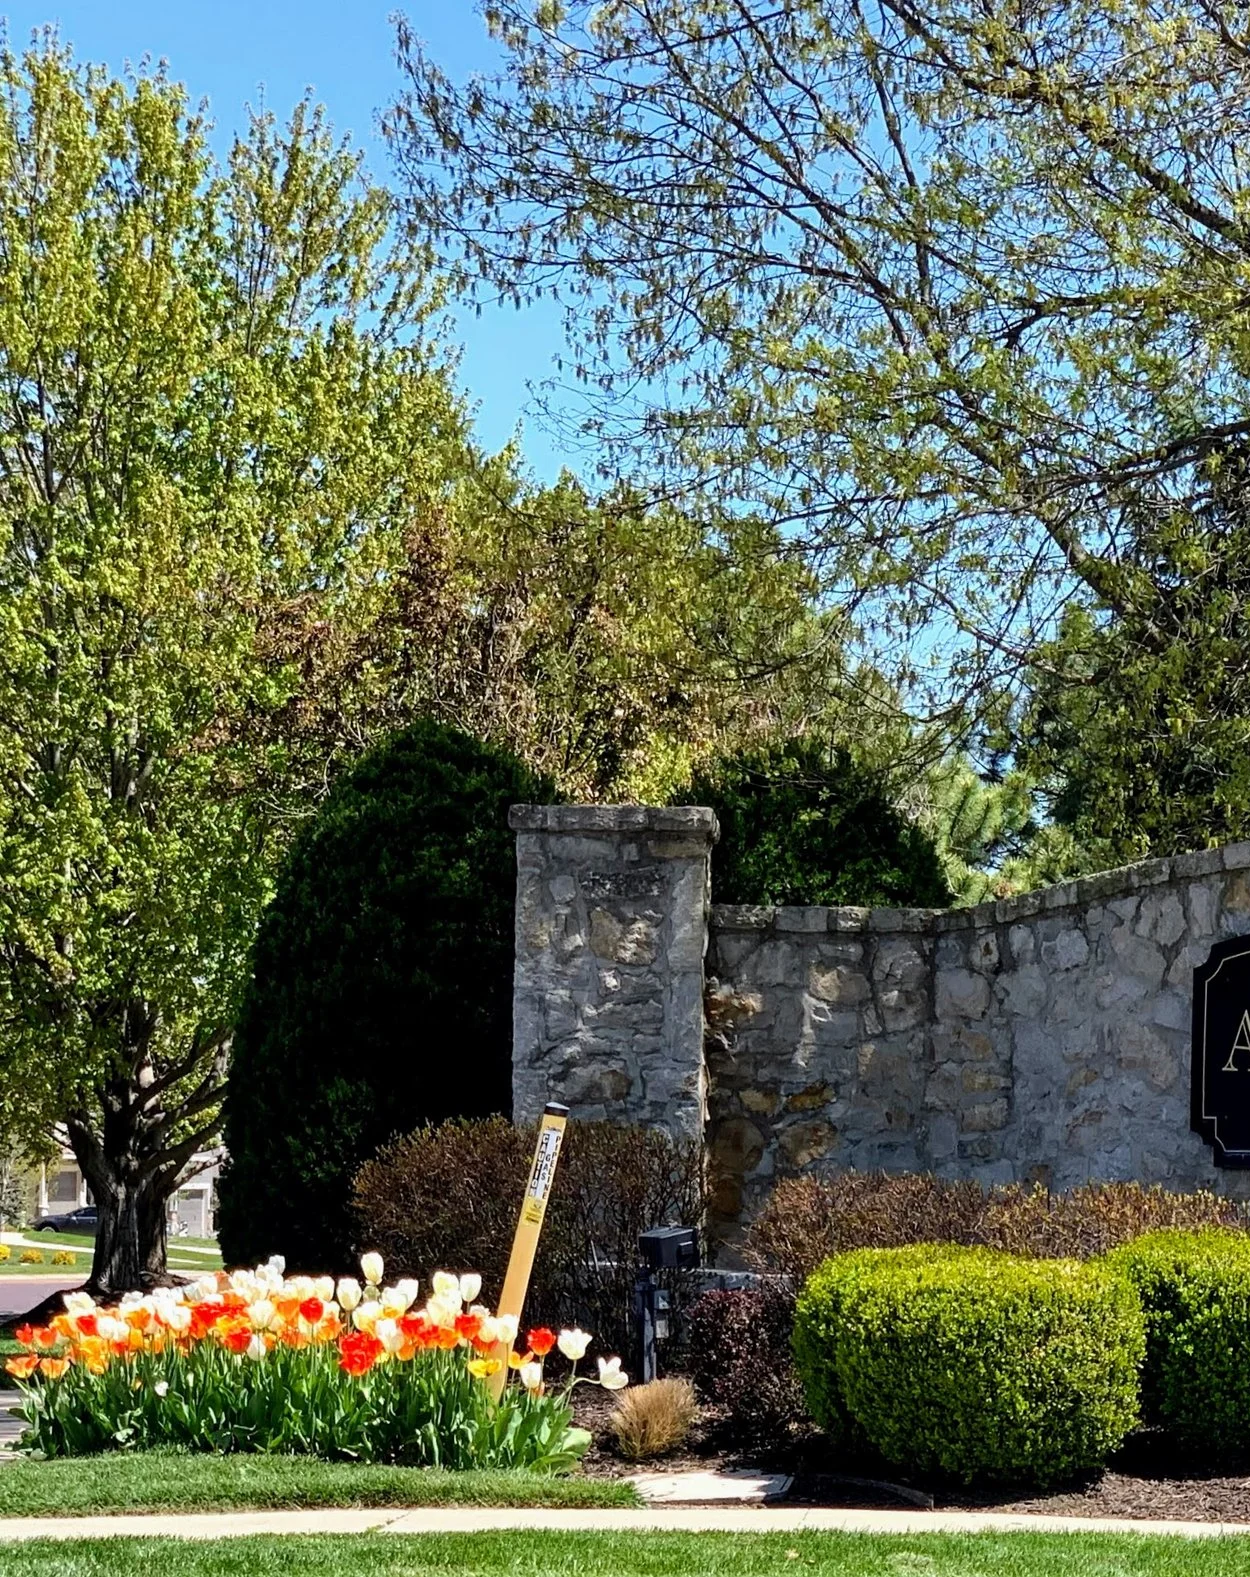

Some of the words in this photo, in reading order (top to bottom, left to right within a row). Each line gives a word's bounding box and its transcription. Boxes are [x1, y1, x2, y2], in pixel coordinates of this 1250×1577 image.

[528, 1134, 550, 1197] CAUTION
[541, 1154, 551, 1181] GAS
[542, 1135, 562, 1200] PIPELINE
